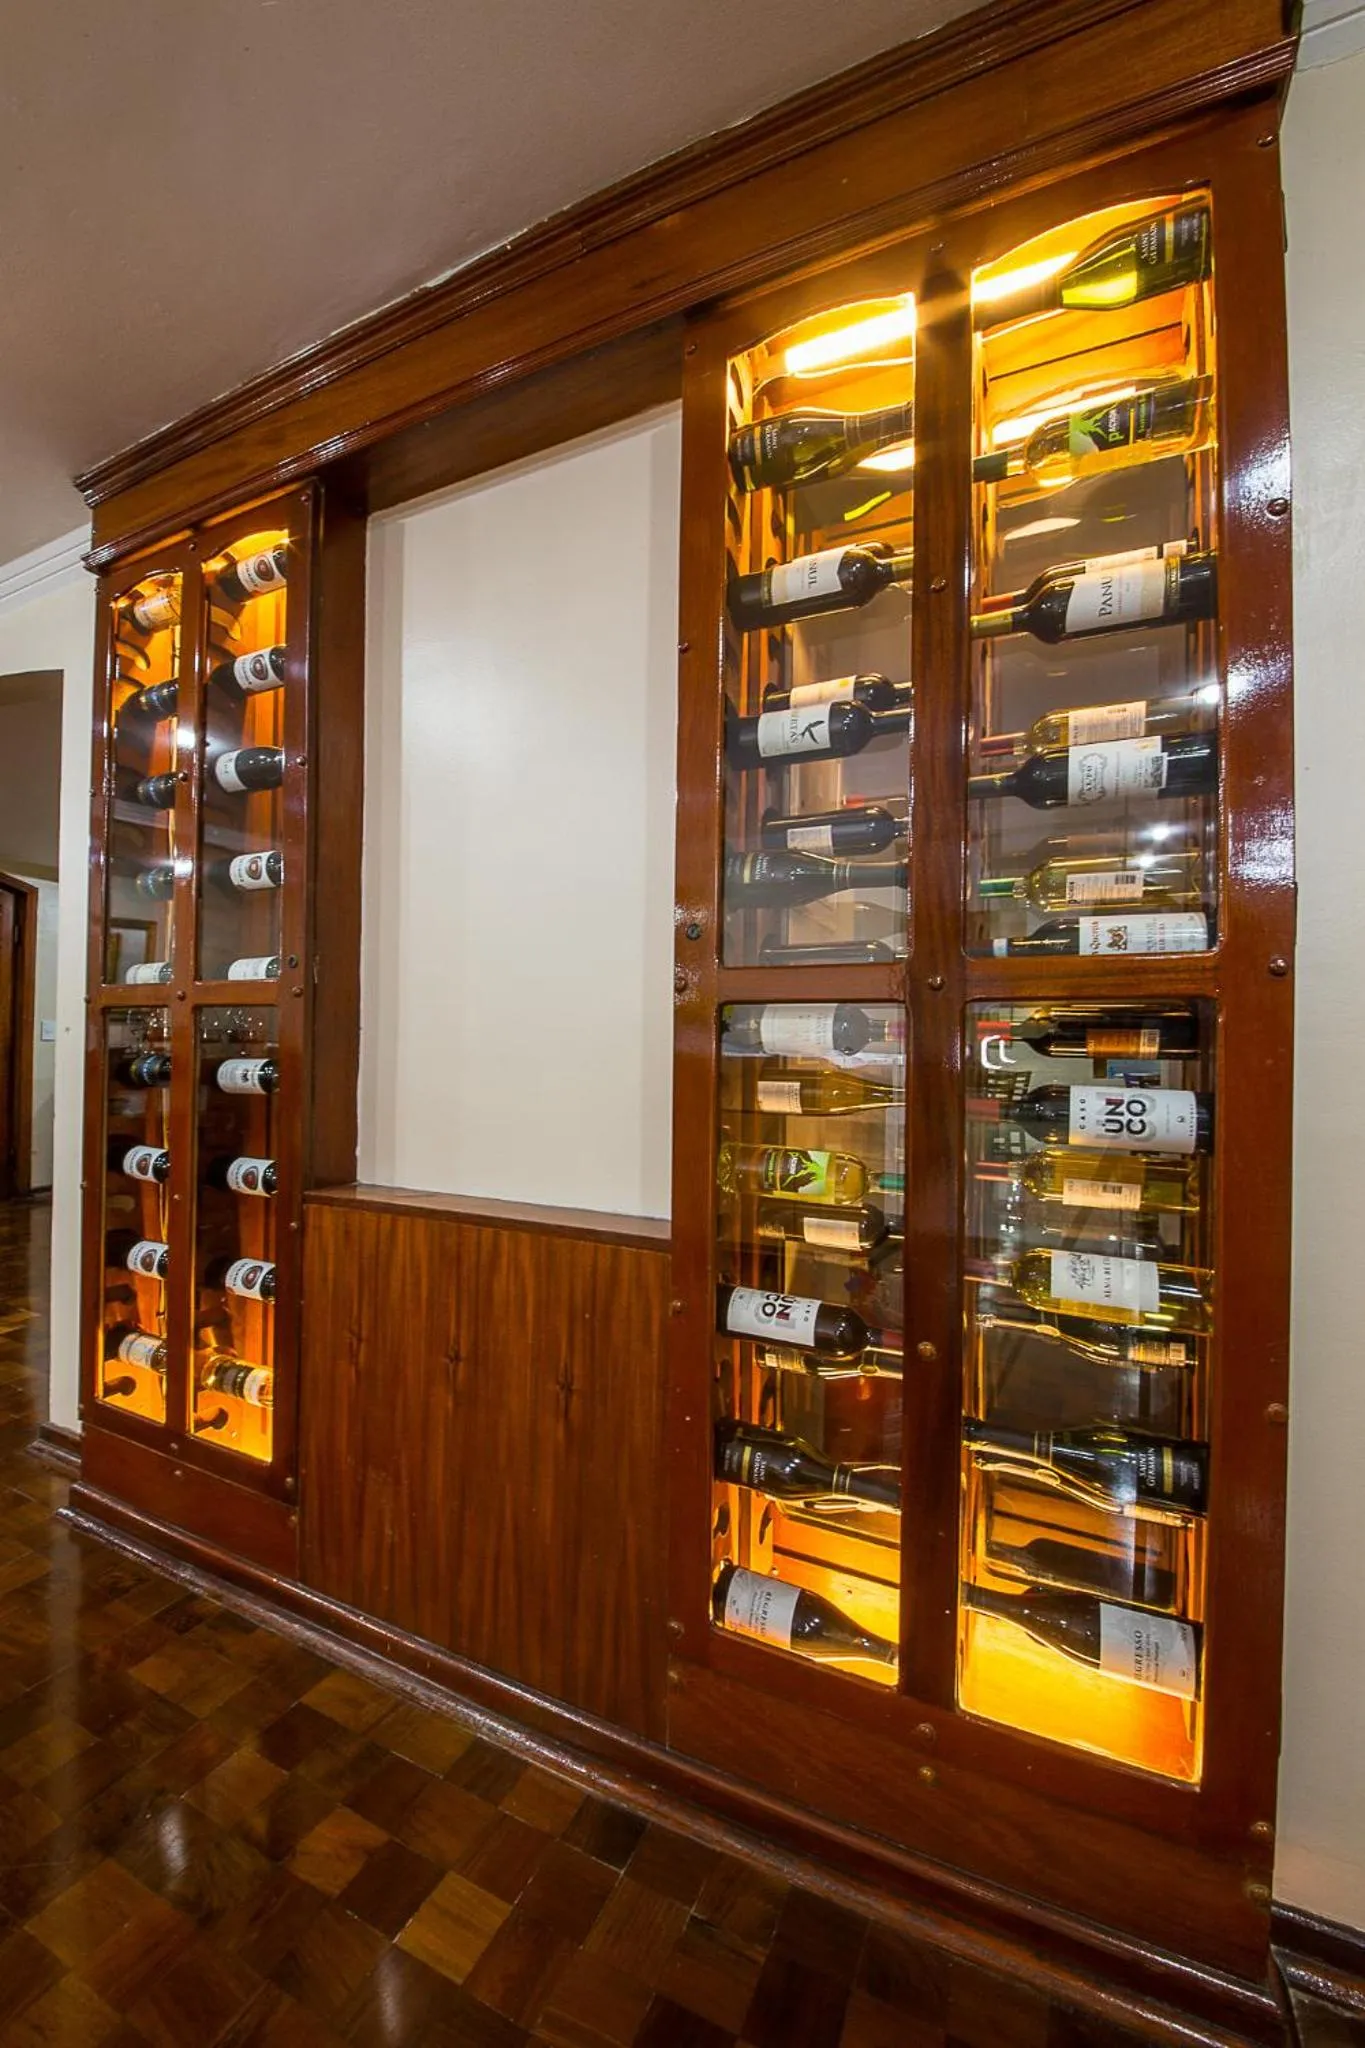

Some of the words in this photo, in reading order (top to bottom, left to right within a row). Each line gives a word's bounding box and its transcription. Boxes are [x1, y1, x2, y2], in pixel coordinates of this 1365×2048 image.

[1079, 1098, 1087, 1130] CASO
[1125, 1099, 1147, 1136] CO
[1139, 1453, 1147, 1478] SAINT
[1146, 1447, 1156, 1487] GERMAIN
